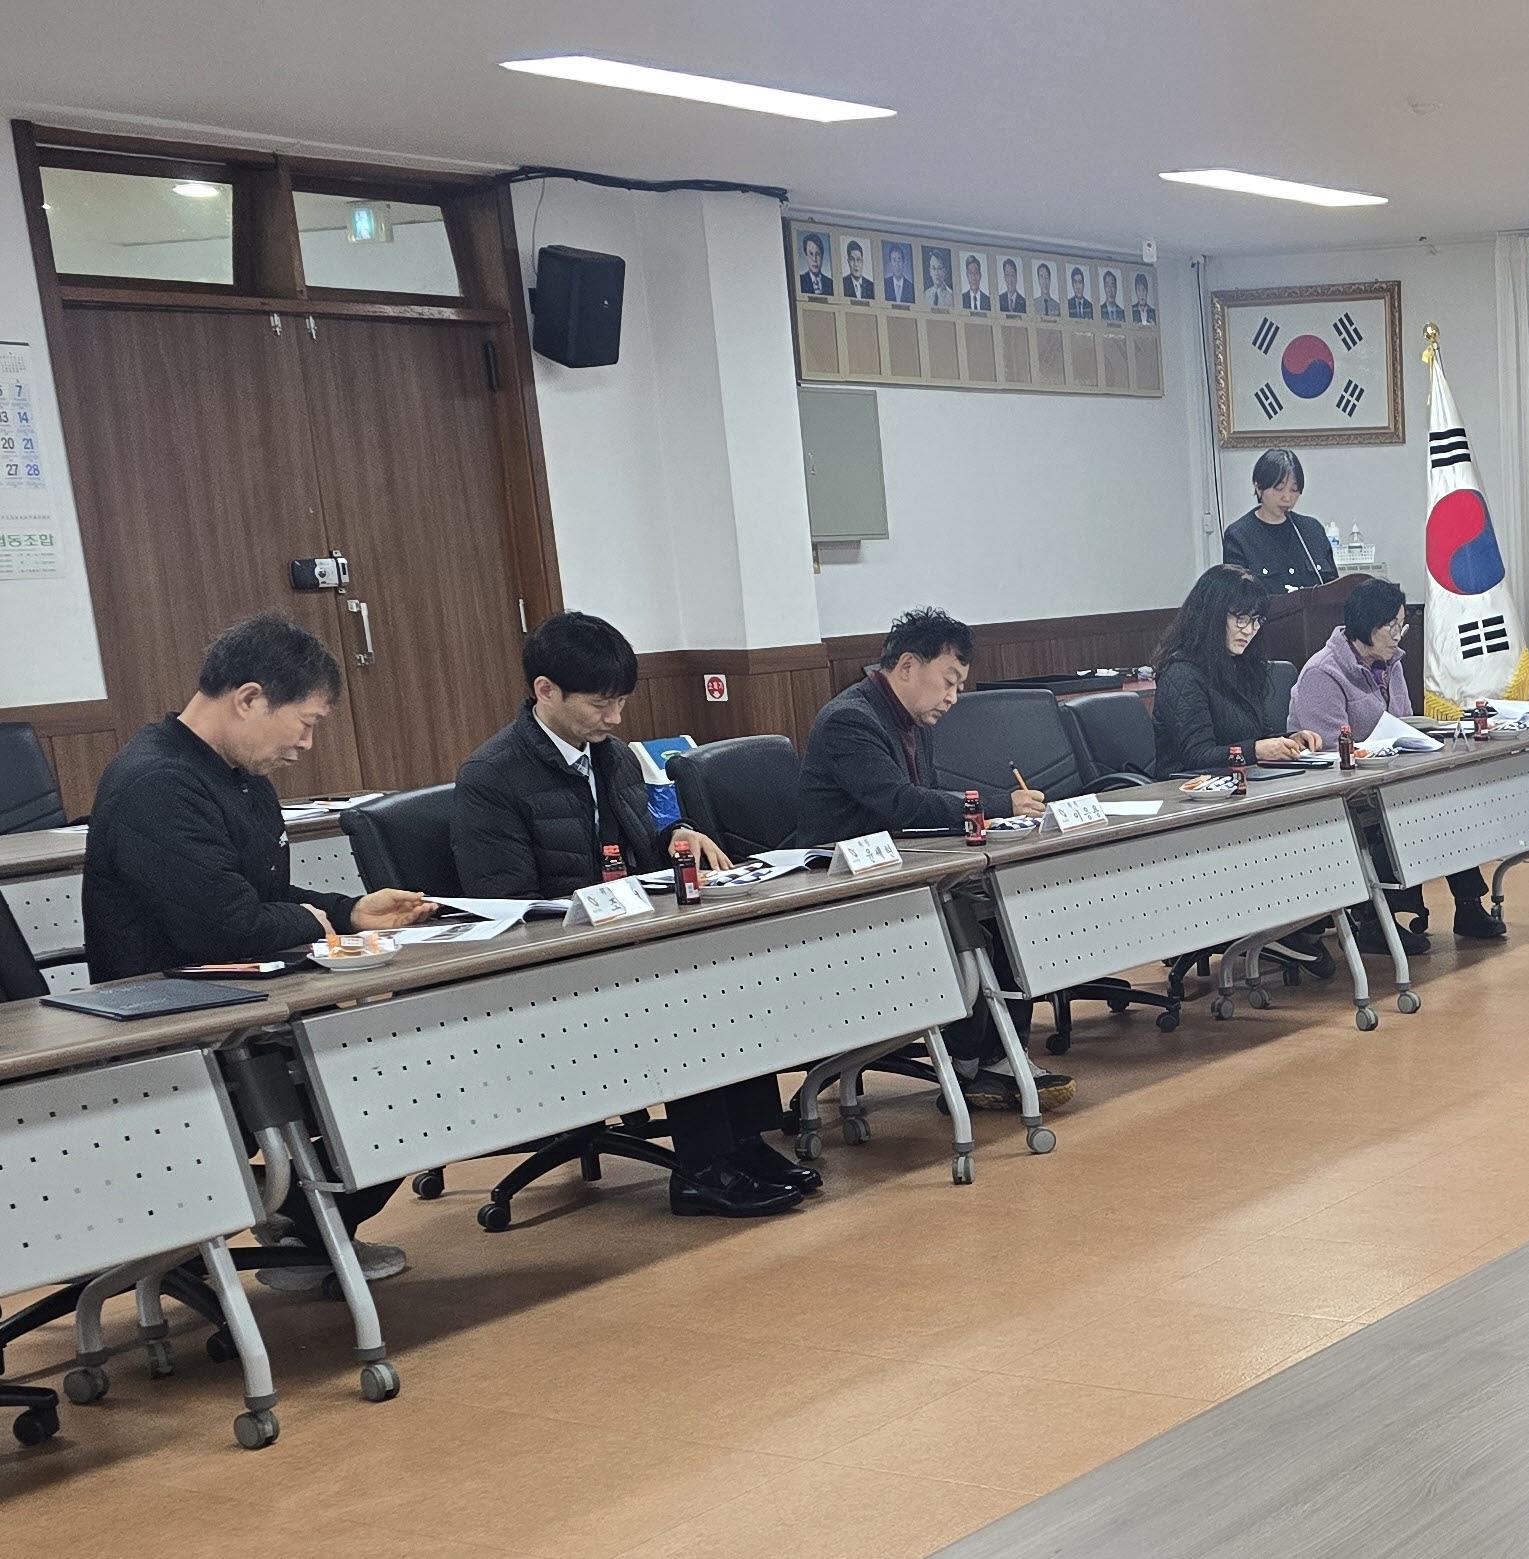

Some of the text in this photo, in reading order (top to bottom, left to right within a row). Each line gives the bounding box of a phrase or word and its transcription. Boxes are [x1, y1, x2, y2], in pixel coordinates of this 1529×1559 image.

[22, 438, 34, 450] 21
[6, 464, 40, 476] 27 28
